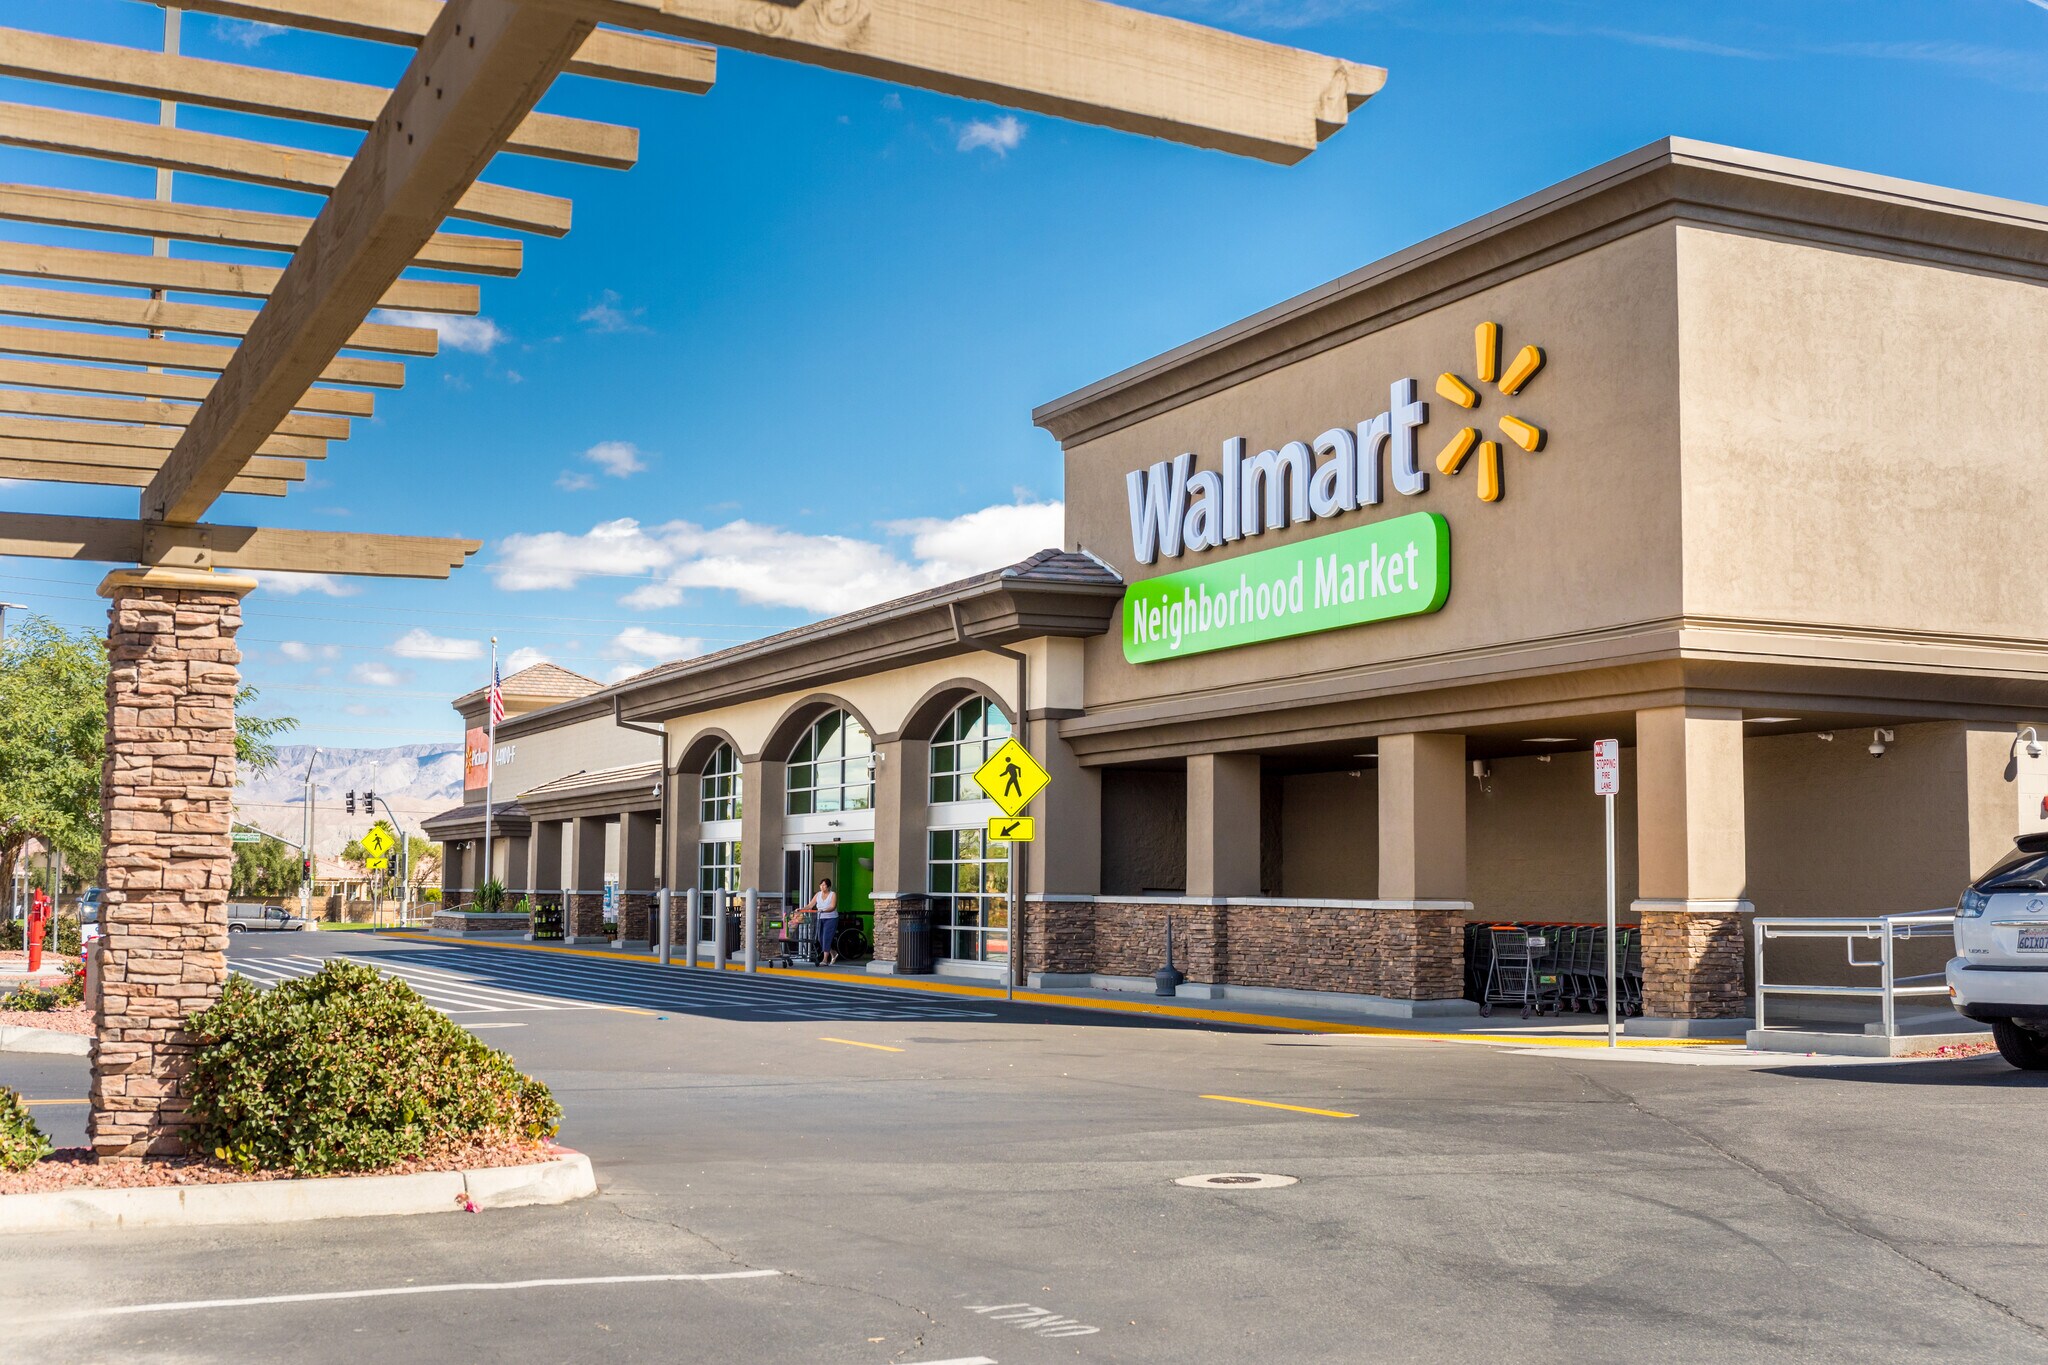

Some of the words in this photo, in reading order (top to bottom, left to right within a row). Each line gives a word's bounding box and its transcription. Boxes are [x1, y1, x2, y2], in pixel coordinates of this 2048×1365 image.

[1126, 377, 1428, 565] Walmart
[1133, 560, 1303, 650] Neighborhood
[1314, 541, 1419, 609] Market
[1596, 758, 1616, 769] STOPPING
[1602, 771, 1611, 779] FIRE
